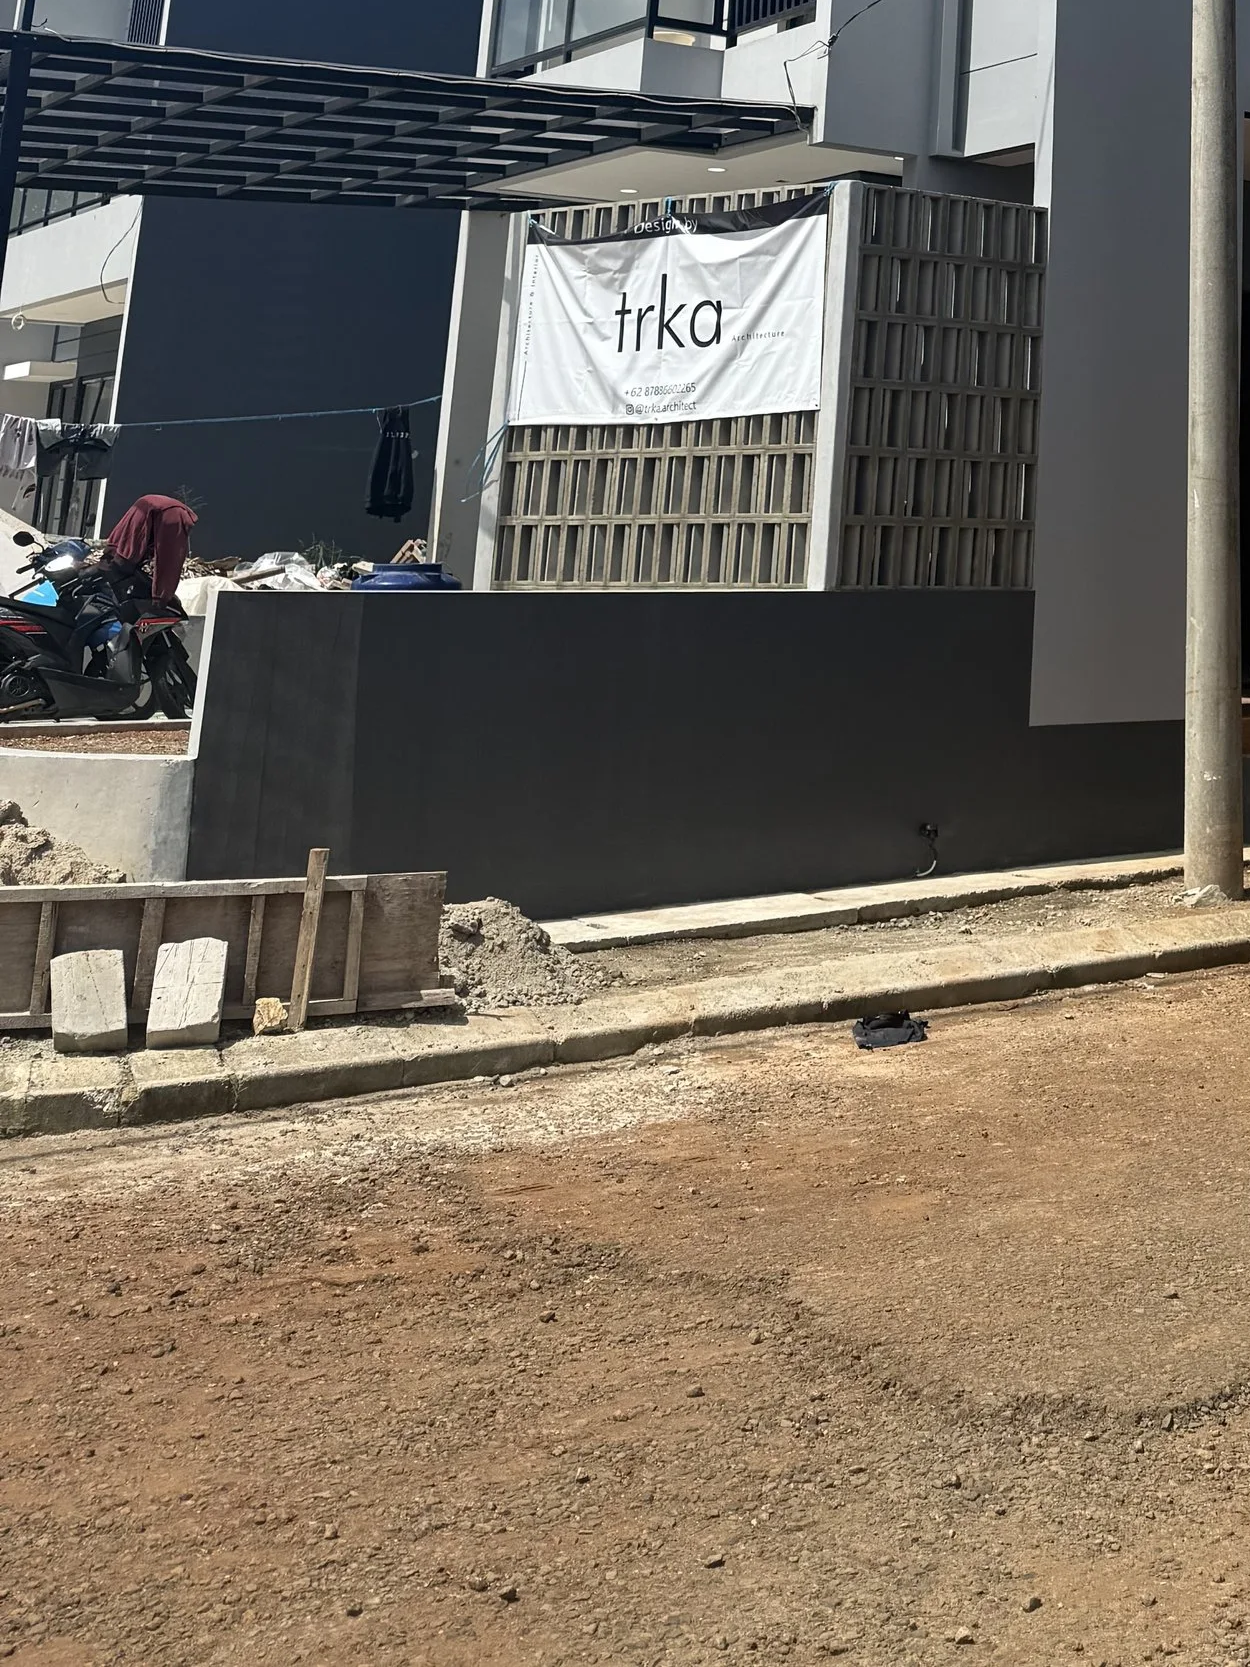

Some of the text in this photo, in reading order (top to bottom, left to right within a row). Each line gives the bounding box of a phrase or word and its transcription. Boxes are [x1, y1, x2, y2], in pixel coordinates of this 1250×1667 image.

[634, 216, 698, 234] Design by
[524, 302, 533, 355] Architecture
[615, 273, 722, 353] trka
[731, 331, 785, 342] Architecture
